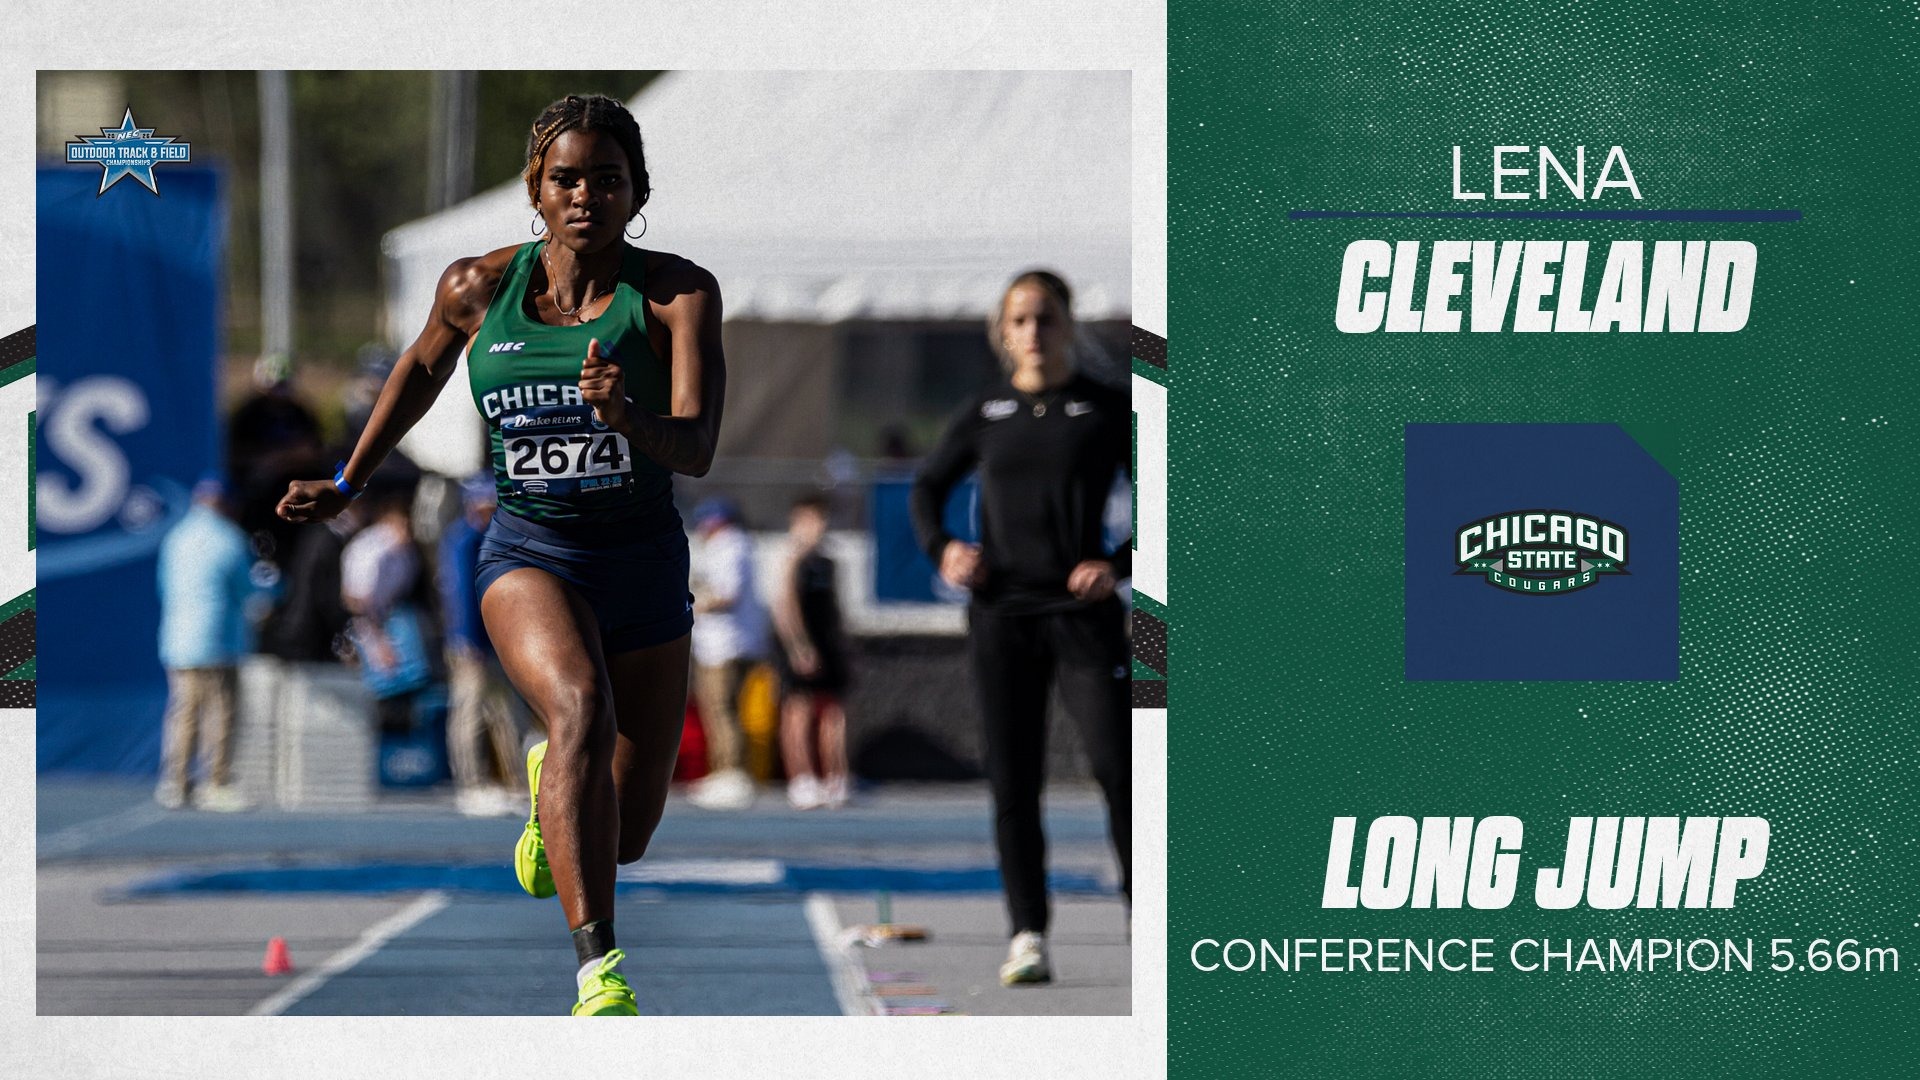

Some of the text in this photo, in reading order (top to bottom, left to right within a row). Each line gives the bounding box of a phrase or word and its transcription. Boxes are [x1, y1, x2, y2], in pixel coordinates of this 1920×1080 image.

[488, 342, 526, 353] NEC
[482, 384, 584, 419] CHICA
[513, 414, 581, 428] Drake RELAYS
[511, 435, 624, 476] 2674
